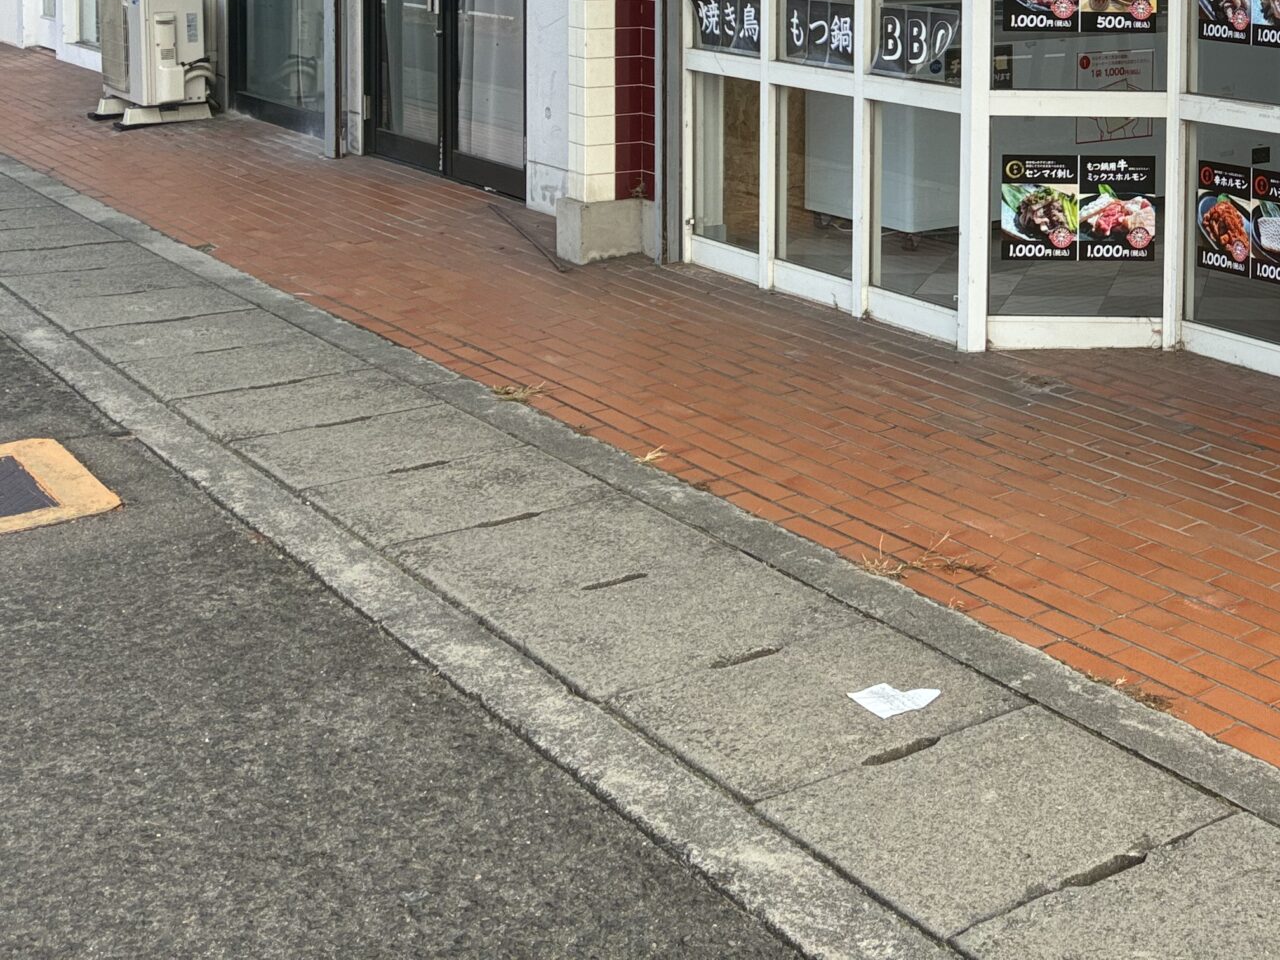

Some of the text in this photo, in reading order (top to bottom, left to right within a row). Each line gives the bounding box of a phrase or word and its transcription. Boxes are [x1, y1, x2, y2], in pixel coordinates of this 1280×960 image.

[698, 0, 760, 42] 焼き鳥
[789, 9, 854, 55] もつ鍋
[1025, 169, 1075, 179] センマイ刺し
[1087, 172, 1148, 182] ミックスホルモン
